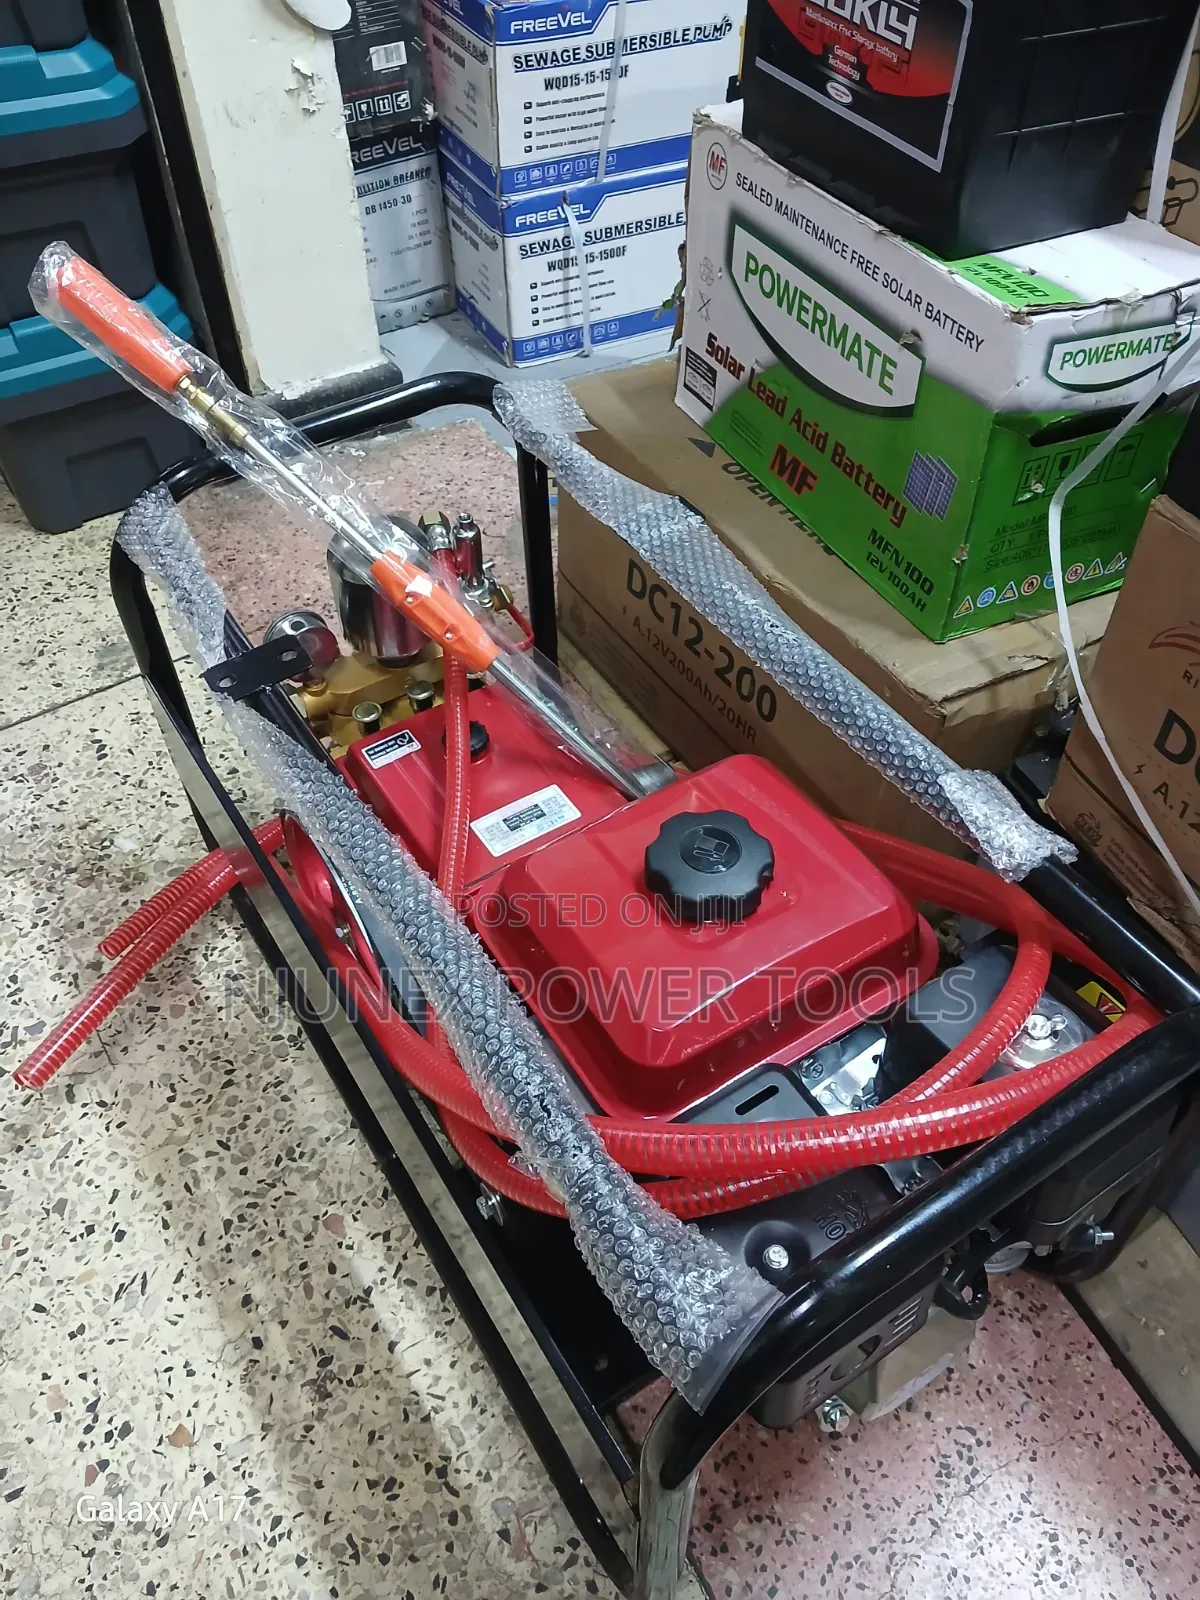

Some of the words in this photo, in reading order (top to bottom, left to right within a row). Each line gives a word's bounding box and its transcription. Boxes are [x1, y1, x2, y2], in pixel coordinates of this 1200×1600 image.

[510, 12, 593, 35] FREEVEL
[805, 6, 839, 32] Maintenance
[838, 22, 852, 38] Free
[851, 30, 876, 49] Storage
[875, 43, 900, 63] battery
[513, 47, 581, 70] SEWAGE
[692, 17, 734, 42] PUMP
[834, 45, 858, 64] German
[543, 64, 630, 91] WQD15-15-150F
[827, 54, 860, 80] Technology
[351, 135, 423, 164] REEVEL
[708, 150, 728, 175] MF
[365, 202, 378, 216] DB
[584, 211, 684, 244] SUBMERSIBLE
[735, 172, 774, 208] SEALED
[774, 198, 850, 260] MAINTENANCE
[850, 250, 880, 283] FREE
[881, 272, 924, 313] SOLAR
[924, 304, 985, 353] BATTERY
[744, 250, 898, 397] POWERMATE
[1059, 333, 1175, 371] POWERMATE
[705, 331, 746, 382] Solar
[747, 365, 789, 419] Lead
[788, 407, 830, 455] Acid
[830, 440, 908, 529] Battery
[769, 442, 819, 497] MF
[626, 557, 778, 724] DC12-200
